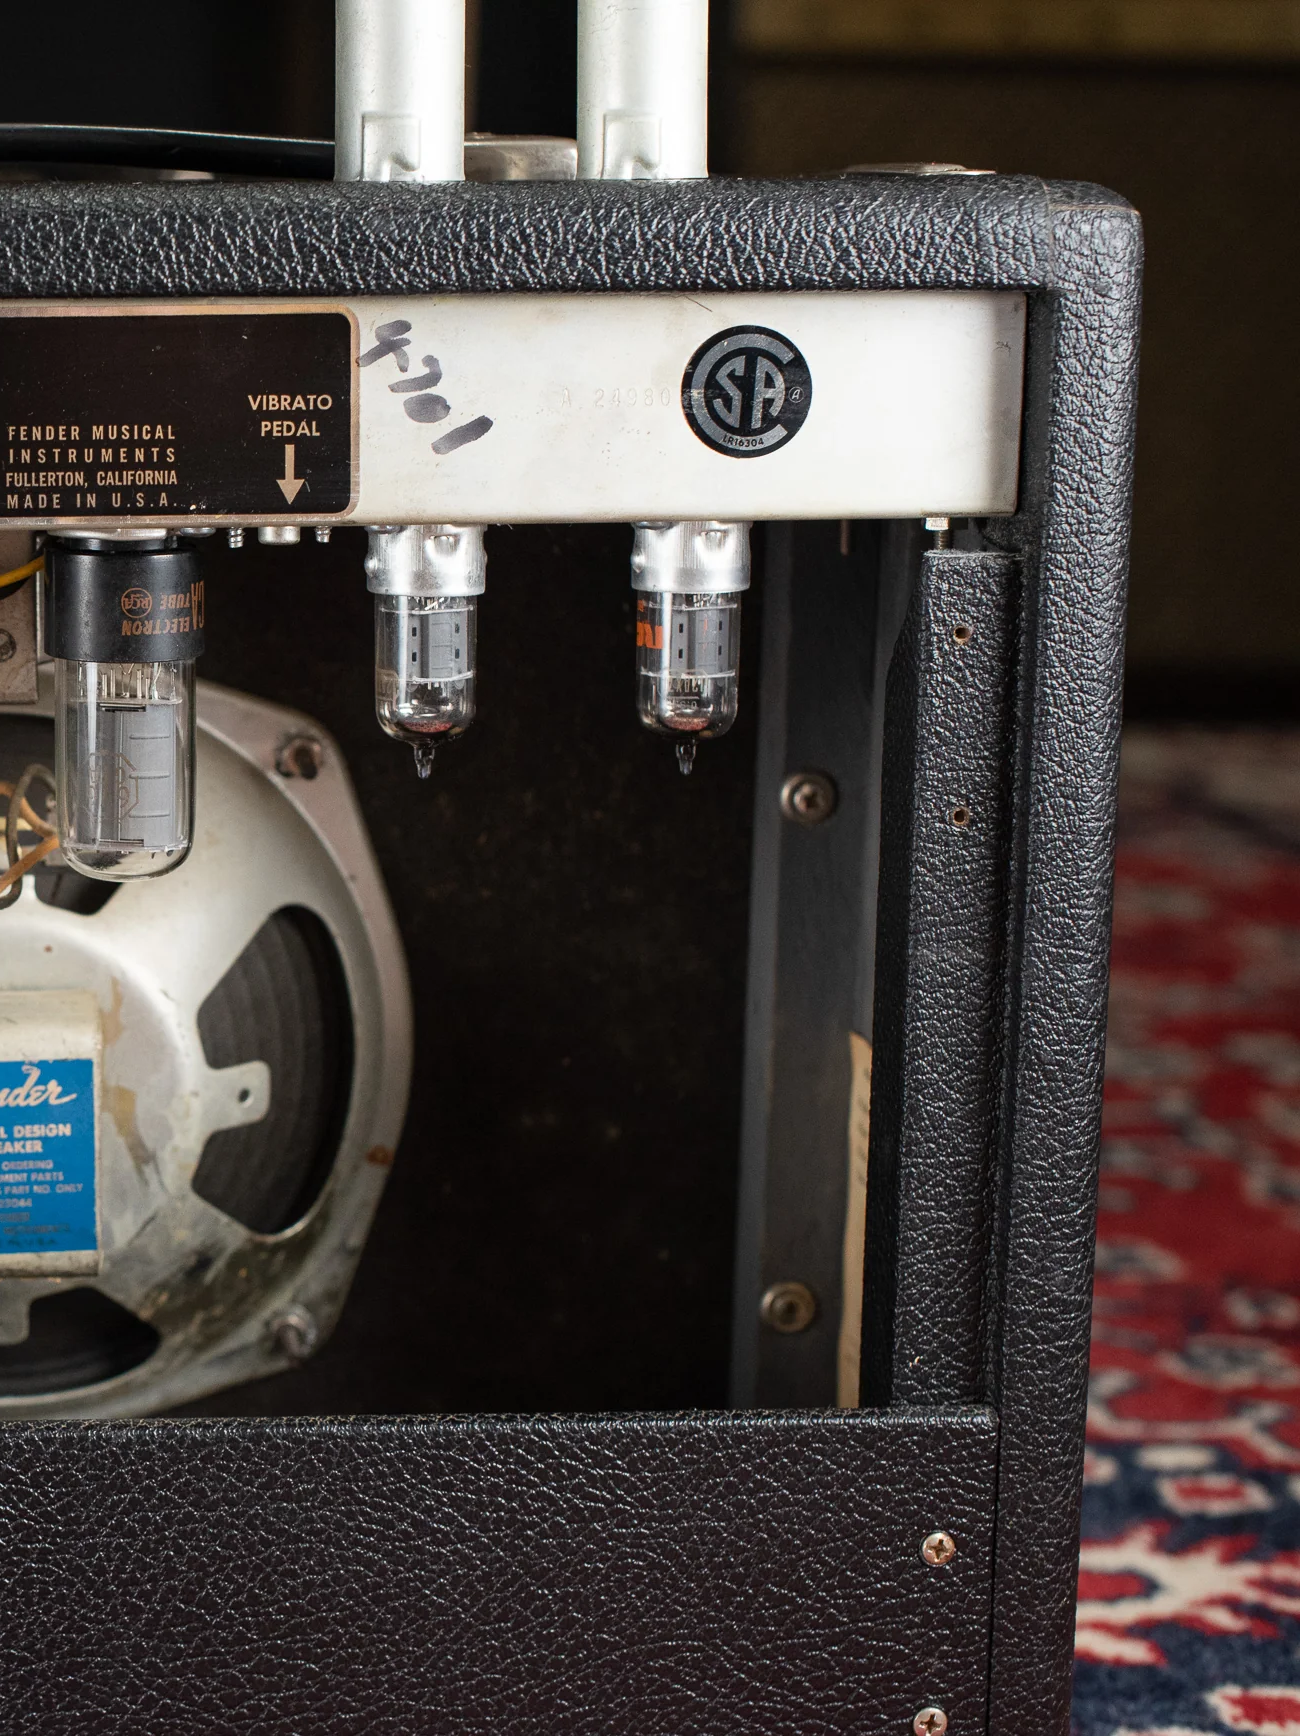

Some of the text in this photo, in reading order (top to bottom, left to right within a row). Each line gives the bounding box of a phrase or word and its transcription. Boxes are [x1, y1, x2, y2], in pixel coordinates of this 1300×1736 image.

[691, 333, 795, 451] CSA
[248, 394, 334, 412] VIBRATO
[8, 424, 177, 442] FENDER MUSICAL
[260, 420, 321, 438] PEDAL
[722, 433, 764, 448] LR16304
[9, 446, 177, 465] INSTRUMENTS
[6, 470, 179, 489] FULLERTON, CALIFORNIA
[6, 491, 180, 510] MADE IN U.S.A.
[123, 591, 191, 612] TUBE RCA
[121, 616, 190, 636] ELECTRON
[13, 1123, 72, 1138] DESIGN
[31, 1172, 64, 1182] PARTS
[4, 1185, 30, 1195] PART
[55, 1183, 83, 1193] ONLY
